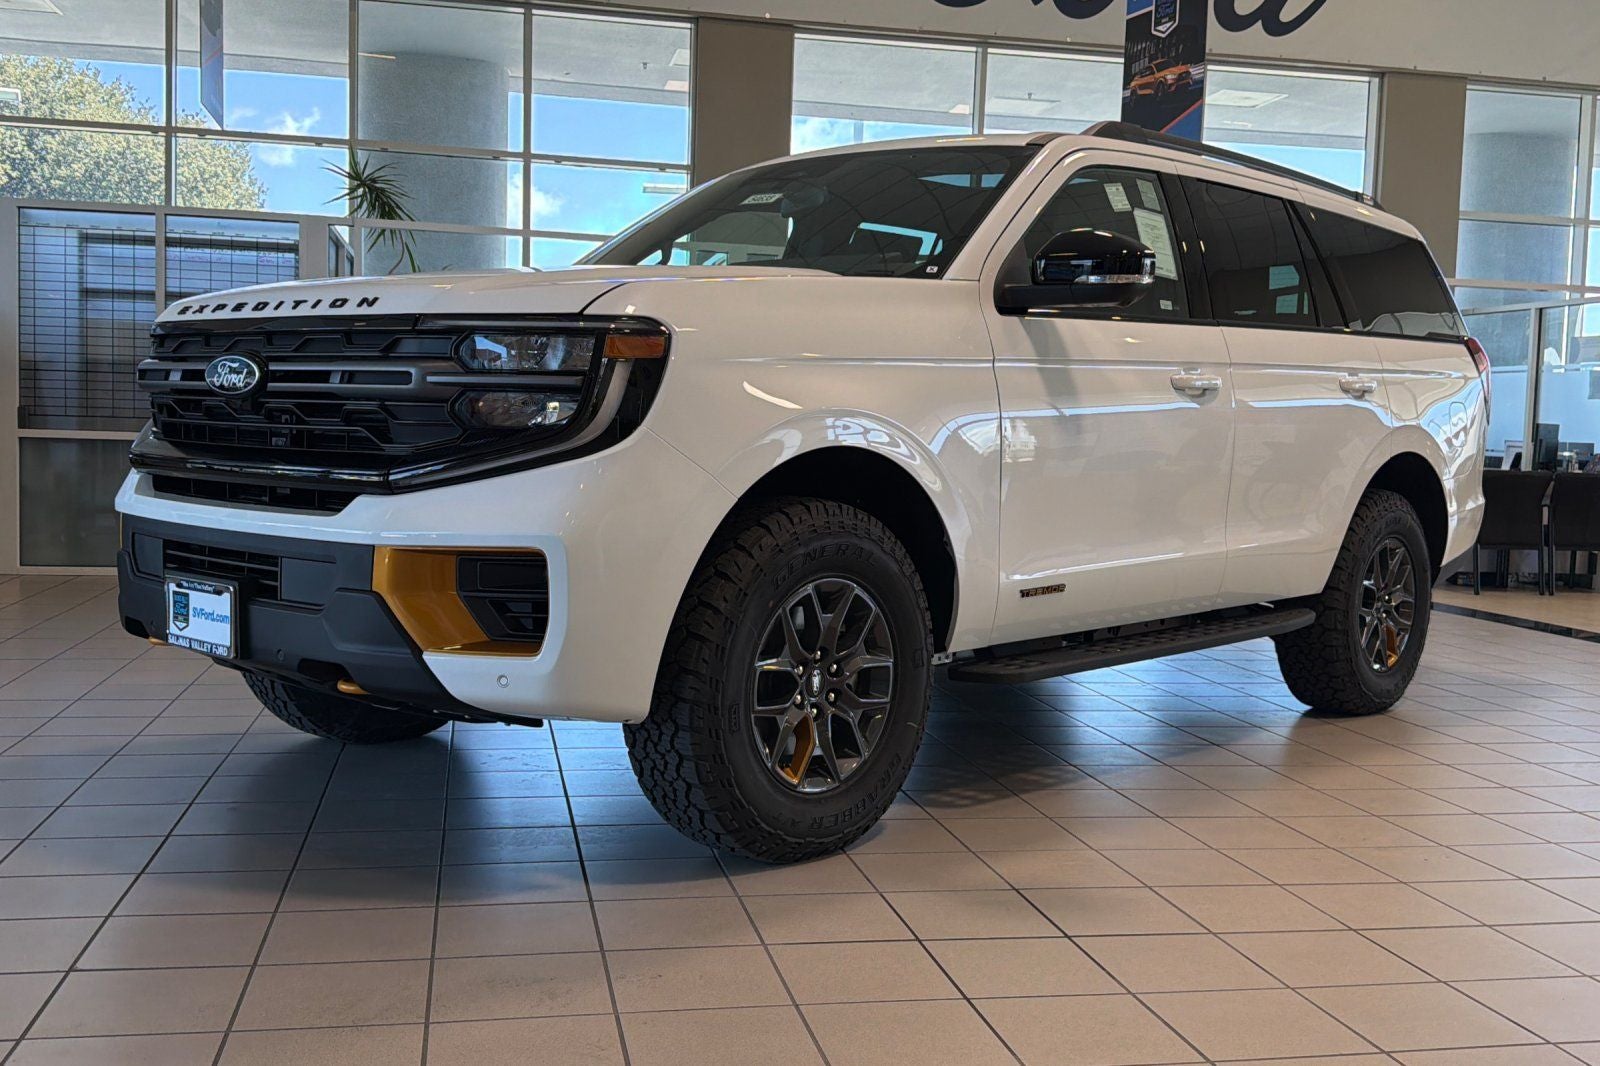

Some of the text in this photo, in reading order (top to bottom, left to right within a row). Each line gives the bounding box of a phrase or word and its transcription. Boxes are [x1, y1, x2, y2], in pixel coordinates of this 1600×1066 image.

[177, 296, 380, 315] EXPEDITION
[210, 360, 250, 388] Ford
[773, 543, 876, 590] GENERAL
[192, 606, 229, 624] SVFord.com
[191, 640, 211, 653] VALLEY
